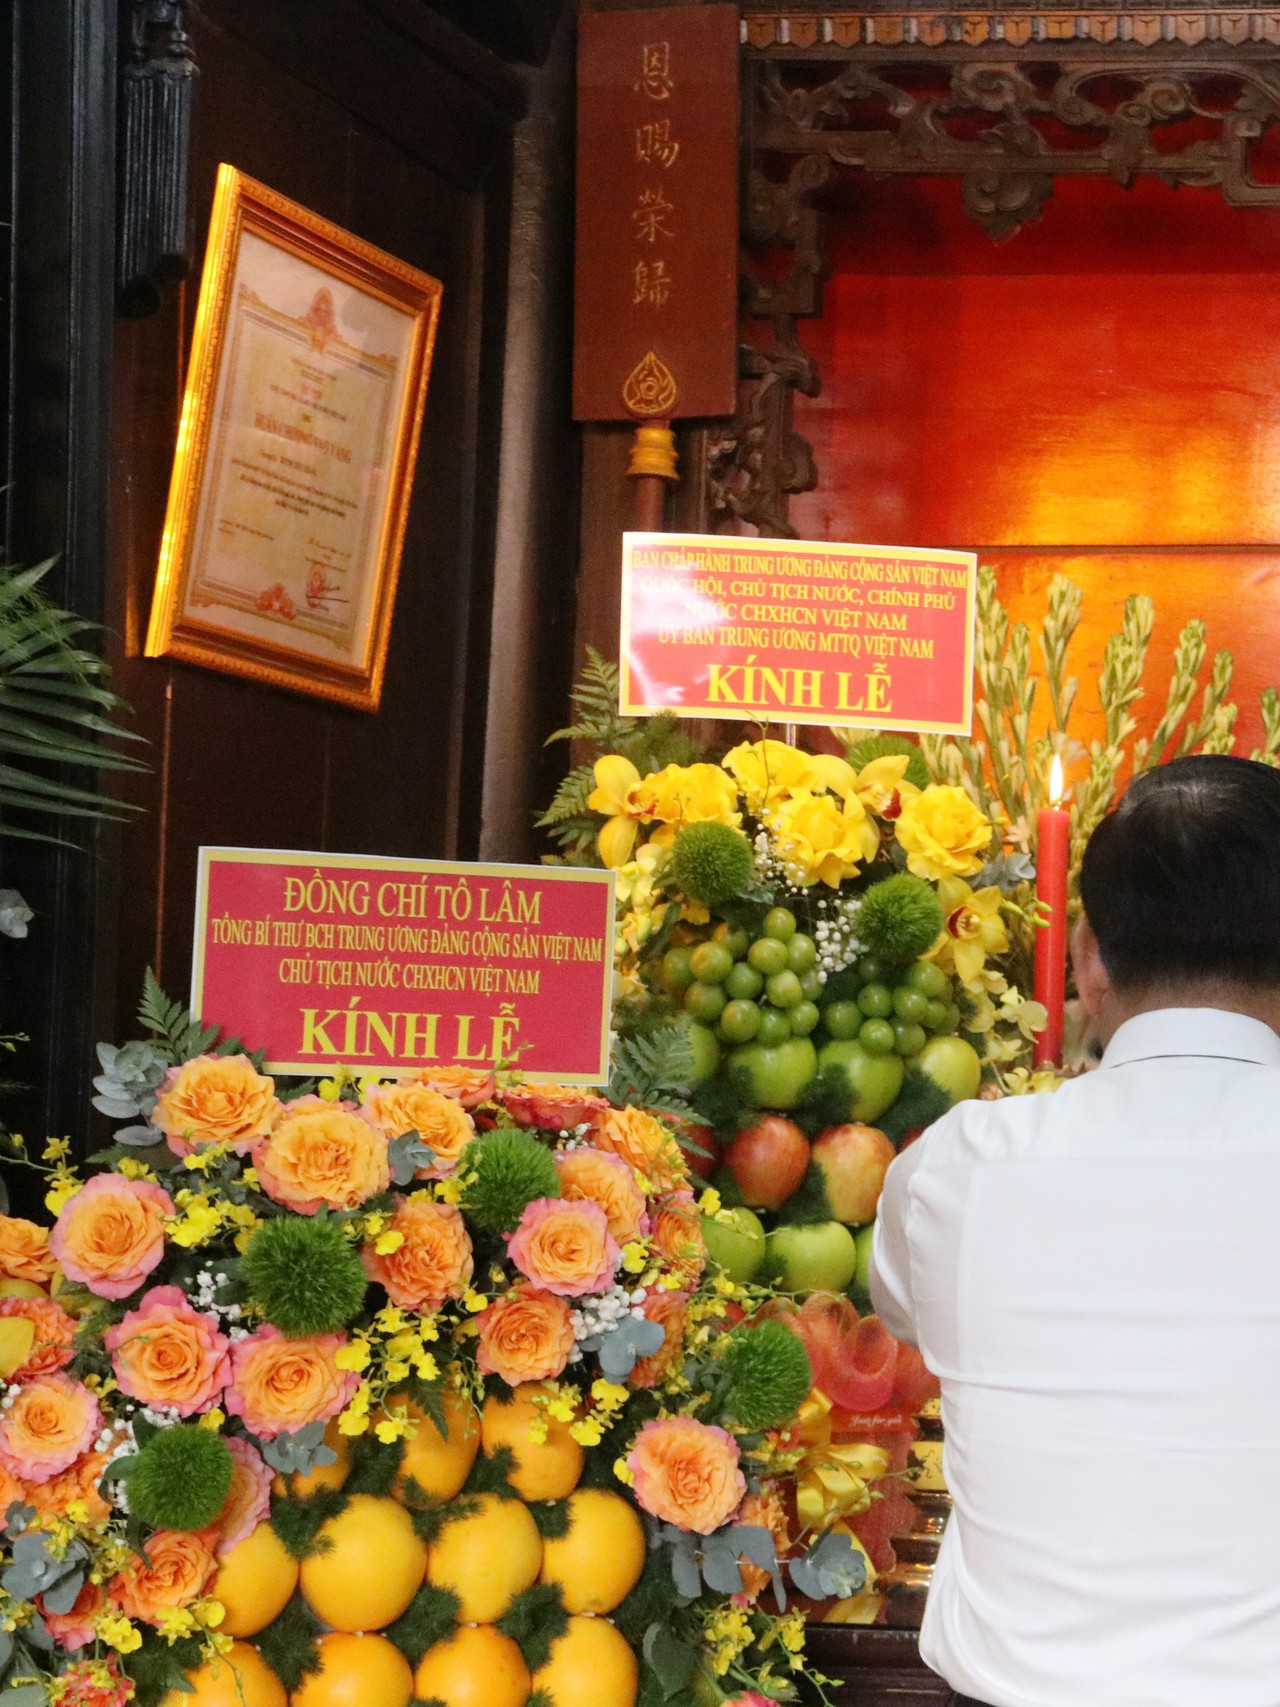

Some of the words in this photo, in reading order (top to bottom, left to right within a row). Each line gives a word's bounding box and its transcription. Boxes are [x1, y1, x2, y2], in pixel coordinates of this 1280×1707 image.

[633, 550, 659, 569] BAN
[662, 547, 696, 570] CHẤP
[696, 549, 730, 573] HÀNH
[733, 555, 775, 575] TRUNG
[776, 556, 812, 577] ƯƠNG
[813, 556, 848, 580] ĐẢNG
[850, 558, 884, 584] CỘNG
[886, 560, 910, 583] SẢN
[911, 564, 940, 589] VIỆT
[940, 568, 967, 589] NAM
[684, 598, 737, 620] NƯỚC
[741, 604, 817, 625] CHXHCN
[821, 608, 862, 630] VIỆT
[865, 612, 908, 631] NAM
[693, 576, 727, 597] HỘI,
[730, 578, 766, 598] CHỦ
[769, 582, 809, 601] TỊCH
[812, 584, 864, 606] NƯỚC,
[867, 587, 920, 607] CHÍNH
[923, 591, 956, 610] PHỦ
[683, 625, 715, 645] BAN
[718, 626, 769, 648] TRUNG
[772, 628, 816, 651] ƯƠNG
[819, 632, 861, 659] MTTQ
[863, 633, 897, 659] VIỆT
[899, 638, 934, 659] NAM
[705, 654, 825, 708] KÍNH
[835, 662, 893, 712] LỄ
[283, 868, 371, 916] ĐỒNG
[377, 875, 429, 919] CHÍ
[434, 876, 472, 921] TÔ
[478, 879, 542, 924] LÂM
[212, 911, 252, 946] TỔNG
[255, 914, 271, 946] BÍ
[273, 919, 304, 948] THƯ
[304, 923, 335, 949] BCH
[338, 925, 385, 952] TRUNG
[388, 924, 428, 954] ƯƠNG
[431, 923, 470, 956] ĐẢNG
[472, 925, 510, 962] CỘNG
[513, 927, 540, 959] SẢN
[541, 931, 573, 965] VIỆT
[573, 937, 602, 962] NAM
[279, 952, 313, 984] CHỦ
[316, 960, 352, 990] TỊCH
[355, 956, 400, 988] NƯỚC
[403, 964, 466, 991] CHXHCN
[469, 963, 503, 998] VIỆT
[504, 969, 540, 995] NAM
[298, 996, 442, 1058] KÍNH
[452, 1002, 521, 1063] LỄ
